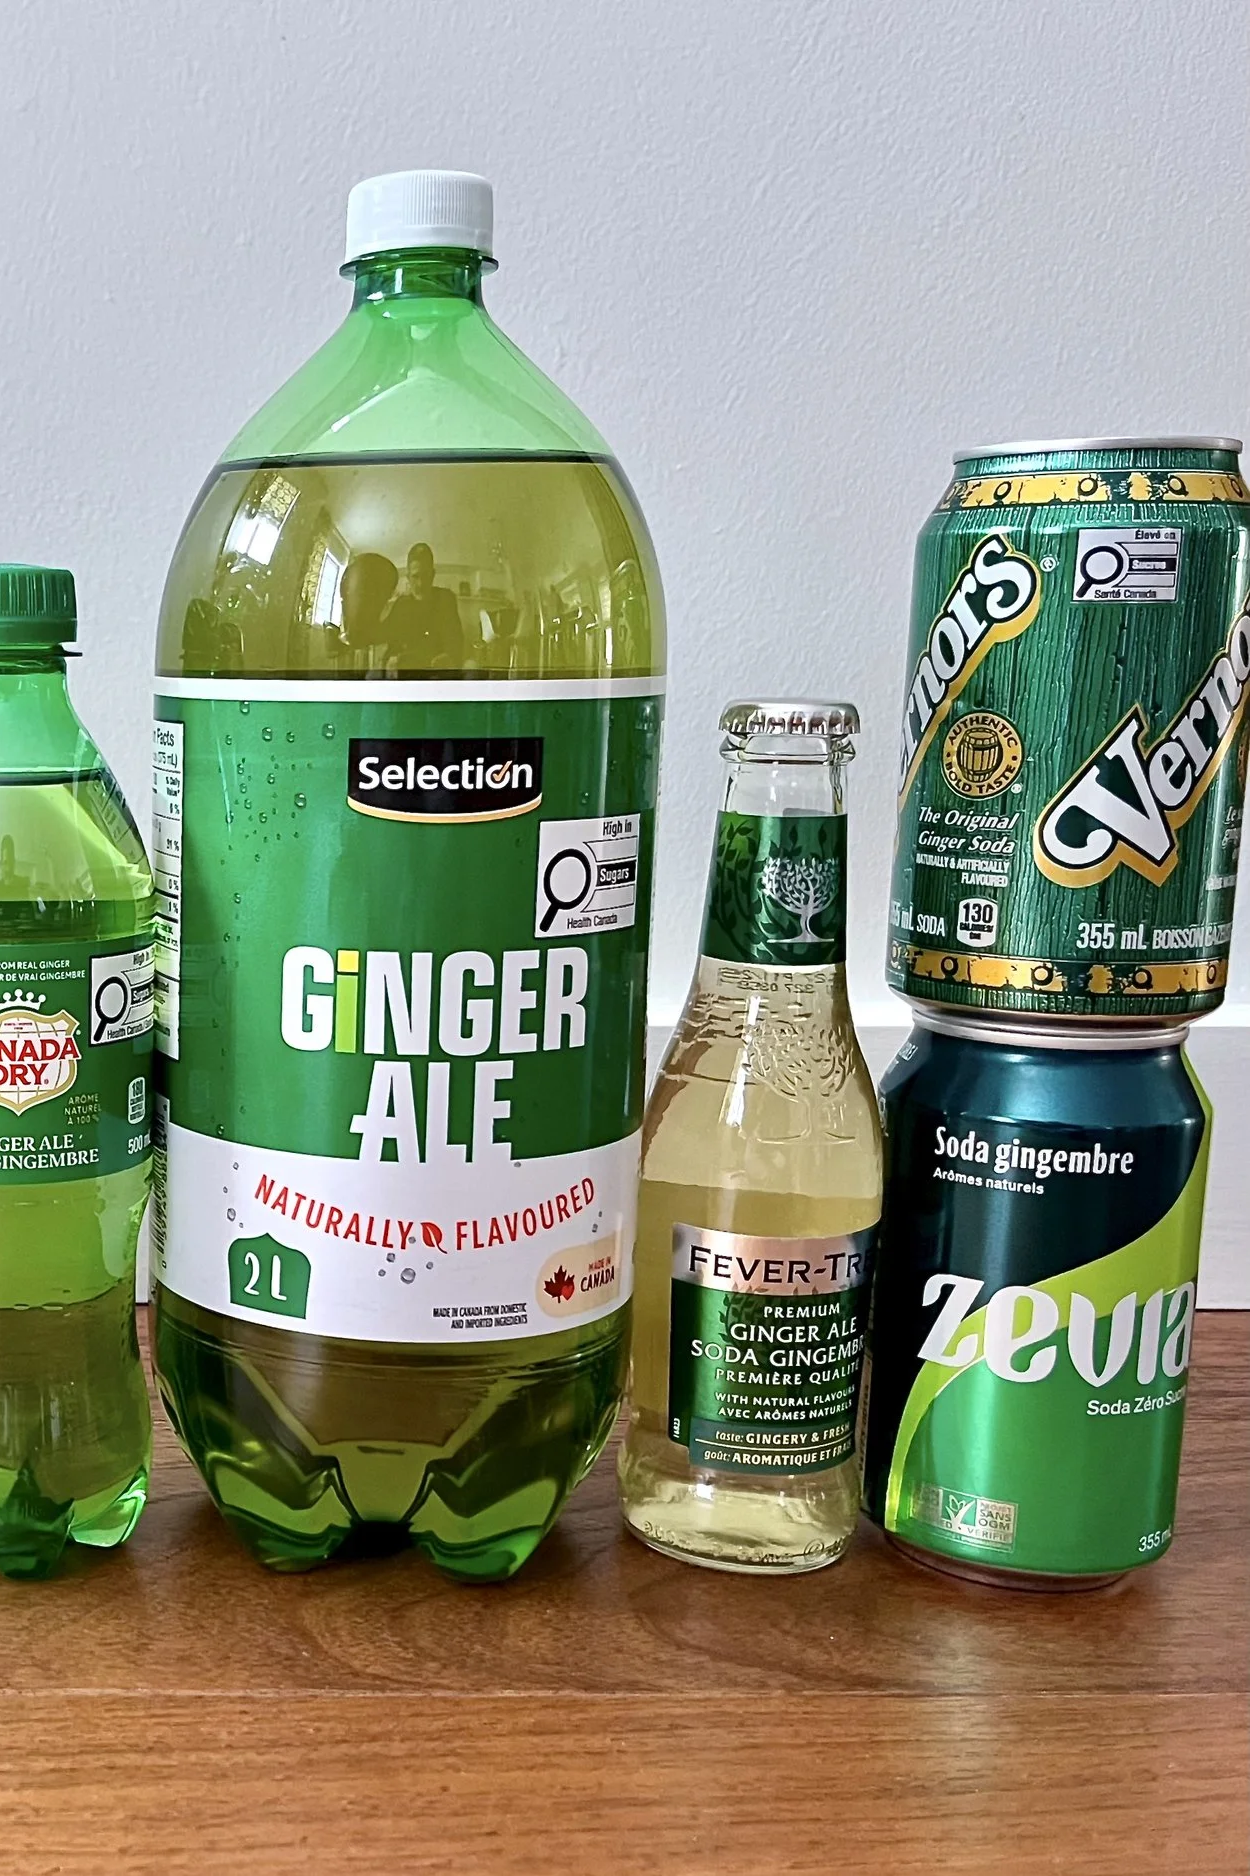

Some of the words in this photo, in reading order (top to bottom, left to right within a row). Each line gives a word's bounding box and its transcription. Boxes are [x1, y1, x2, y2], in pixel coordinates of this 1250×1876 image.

[949, 714, 1018, 748] AUTHENTIC
[358, 756, 533, 791] Selection
[946, 760, 972, 793] BOLD
[976, 764, 1016, 794] TASTE
[602, 820, 622, 837] High
[624, 818, 633, 833] in
[918, 807, 941, 824] The
[944, 809, 1020, 832] Original
[918, 830, 965, 852] Ginger
[968, 835, 1016, 854] Soda
[916, 853, 949, 868] NATURALLY
[957, 858, 1010, 873] ARTIFICIALLY
[599, 867, 630, 886] Sugars
[961, 872, 1009, 888] FLAVOURED
[566, 916, 591, 930] Health
[593, 913, 618, 928] Canada
[962, 903, 994, 923] 130
[917, 914, 945, 937] SODA
[1076, 922, 1115, 949] 355
[1120, 923, 1147, 949] mL
[1152, 927, 1205, 949] BOISSON
[17, 961, 37, 970] REAL
[39, 960, 70, 970] GINGER
[5, 973, 17, 982] DE
[18, 973, 38, 981] VRAI
[39, 969, 86, 981] GINGEMBRE
[64, 1105, 102, 1115] NATUREL
[76, 1115, 91, 1125] 100
[349, 1060, 514, 1164] ALE
[39, 1134, 74, 1150] ALE
[128, 1135, 143, 1154] 500
[934, 1126, 989, 1164] Soda
[993, 1138, 1134, 1179] gingembre
[933, 1167, 983, 1187] Arômes
[986, 1177, 1044, 1195] naturels
[254, 1173, 414, 1250] NATURALLY
[456, 1177, 595, 1251] FLAVOURED
[244, 1251, 261, 1296] 2
[270, 1254, 287, 1301] L
[580, 1265, 615, 1292] CANADA
[433, 1307, 450, 1318] MADE
[484, 1305, 499, 1316] FROM
[764, 1303, 840, 1319] PREMIUM
[730, 1323, 820, 1343] GINGER
[827, 1316, 858, 1340] ALE
[691, 1339, 760, 1367] SODA
[769, 1334, 864, 1367] GINGEMBR
[716, 1368, 802, 1386] PREMIÈRE
[715, 1391, 749, 1405] WITH
[753, 1396, 810, 1407] NATURAL
[813, 1384, 856, 1405] FLAVOURS
[1086, 1400, 1131, 1416] Soda
[1134, 1395, 1164, 1413] Zéro
[718, 1406, 750, 1419] AVEC
[754, 1408, 806, 1421] ARÔMES
[809, 1399, 853, 1419] NATURELS
[715, 1430, 744, 1443] taste:
[745, 1433, 808, 1445] GINGERY
[810, 1432, 820, 1442] &
[732, 1452, 817, 1467] AROMATIQUE
[819, 1451, 830, 1461] ET
[978, 1518, 1010, 1530] OGM
[979, 1509, 1012, 1521] SANS
[1138, 1531, 1161, 1552] 355
